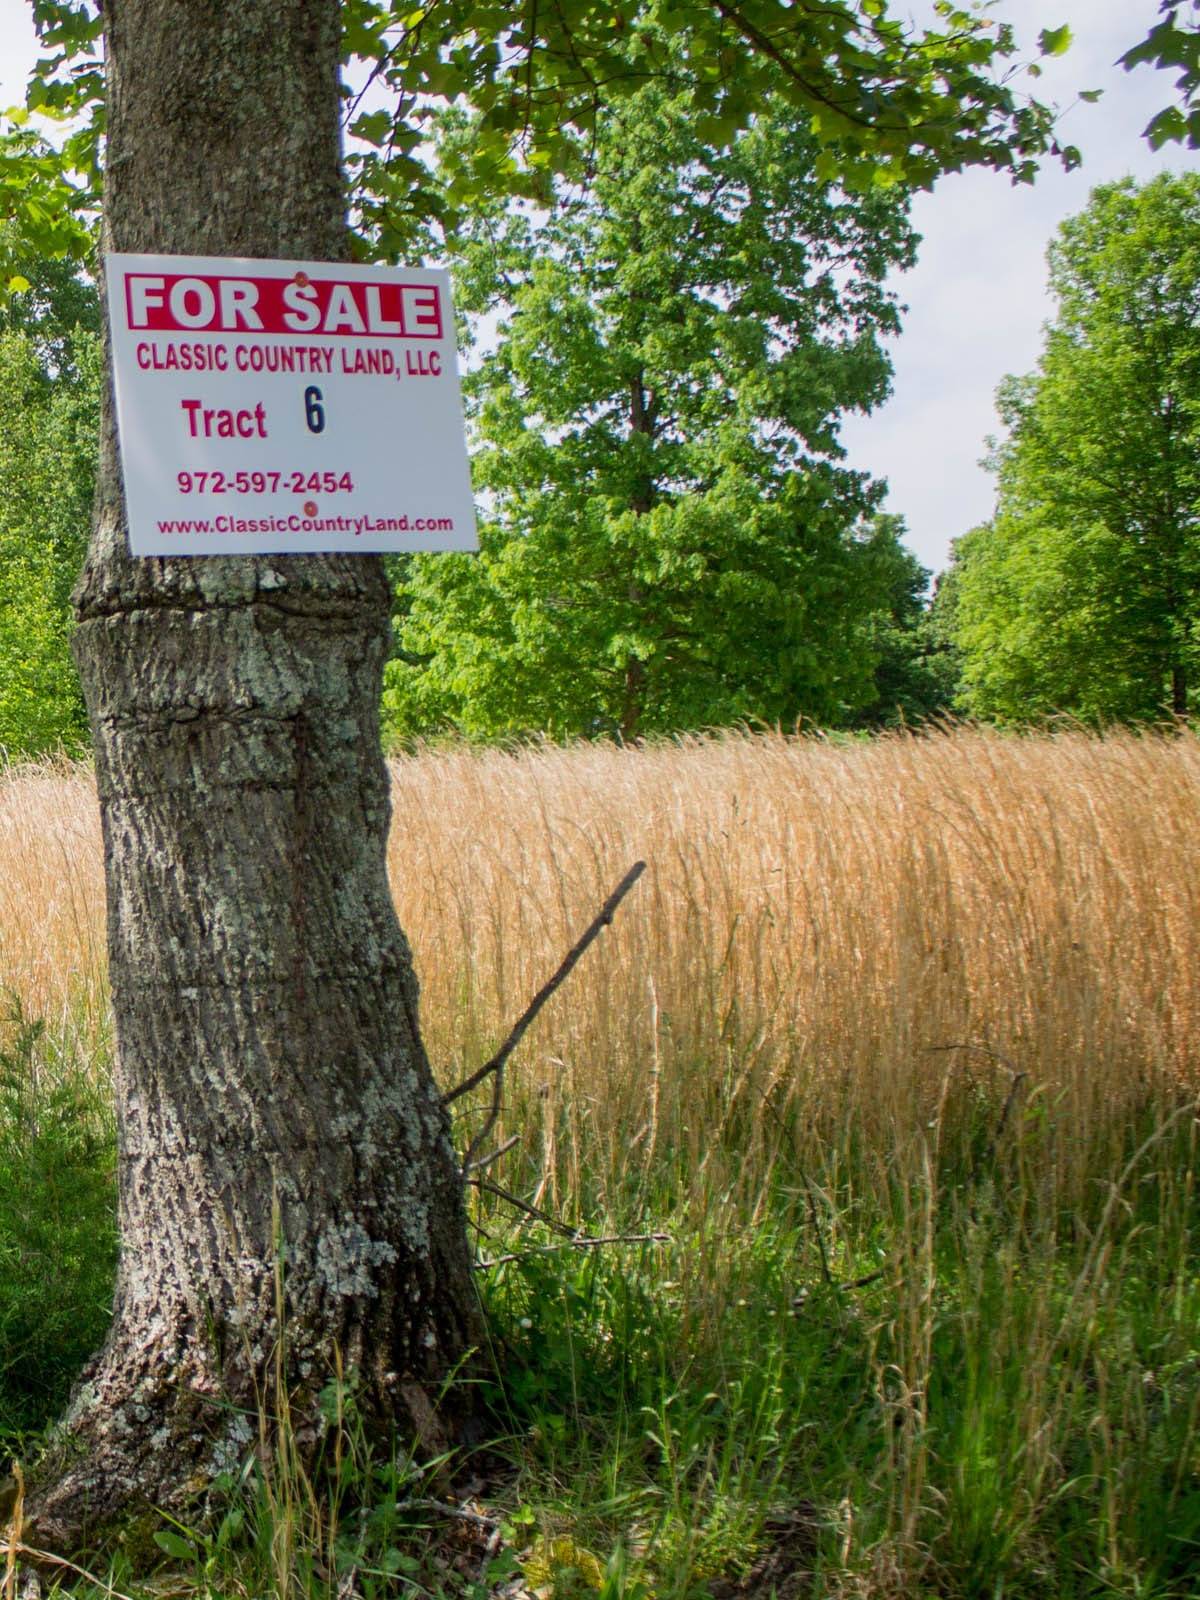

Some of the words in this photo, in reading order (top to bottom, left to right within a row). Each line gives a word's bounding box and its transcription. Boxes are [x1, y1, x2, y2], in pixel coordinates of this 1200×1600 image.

[129, 277, 264, 330] FOR
[282, 280, 440, 336] SALE
[136, 342, 229, 371] CLASSIC
[235, 344, 334, 373] COUNTRY
[341, 347, 401, 380] LAND,
[406, 350, 442, 376] LLC
[181, 399, 268, 438] Tract
[304, 385, 325, 434] 6
[177, 471, 354, 494] 972-597-2454
[157, 514, 453, 536] www.ClassicCountryLand.com
